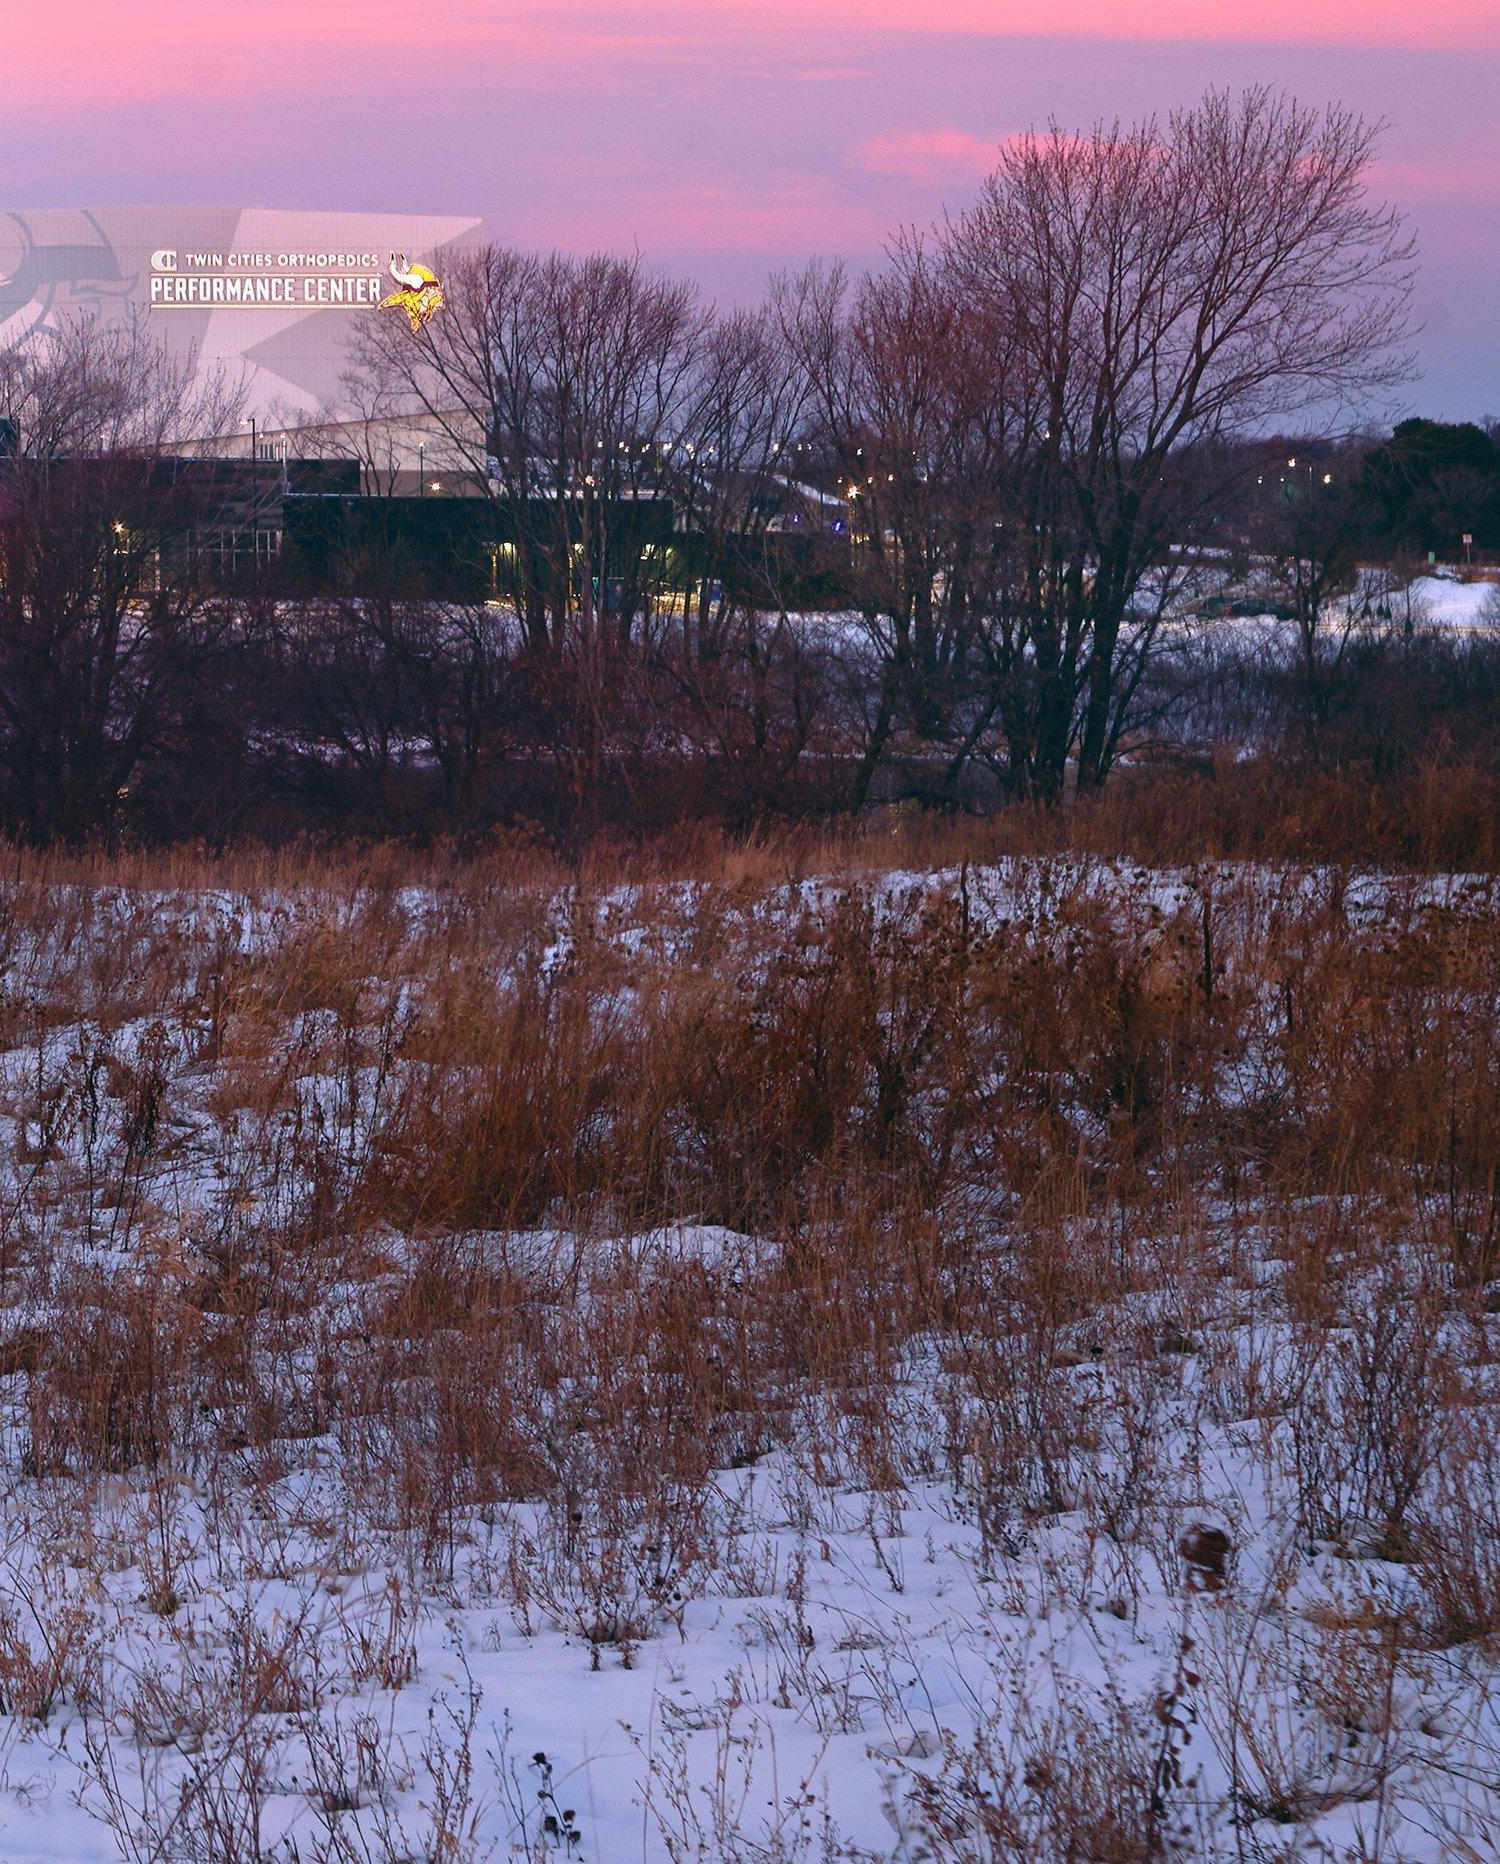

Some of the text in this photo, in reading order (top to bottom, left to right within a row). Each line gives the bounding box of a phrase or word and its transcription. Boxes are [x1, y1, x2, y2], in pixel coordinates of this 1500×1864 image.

[185, 253, 223, 267] TWIN
[227, 253, 273, 267] CITIES
[277, 253, 380, 268] ORTHOPEDICS
[150, 277, 382, 302] PERFORMANCE CENTER
